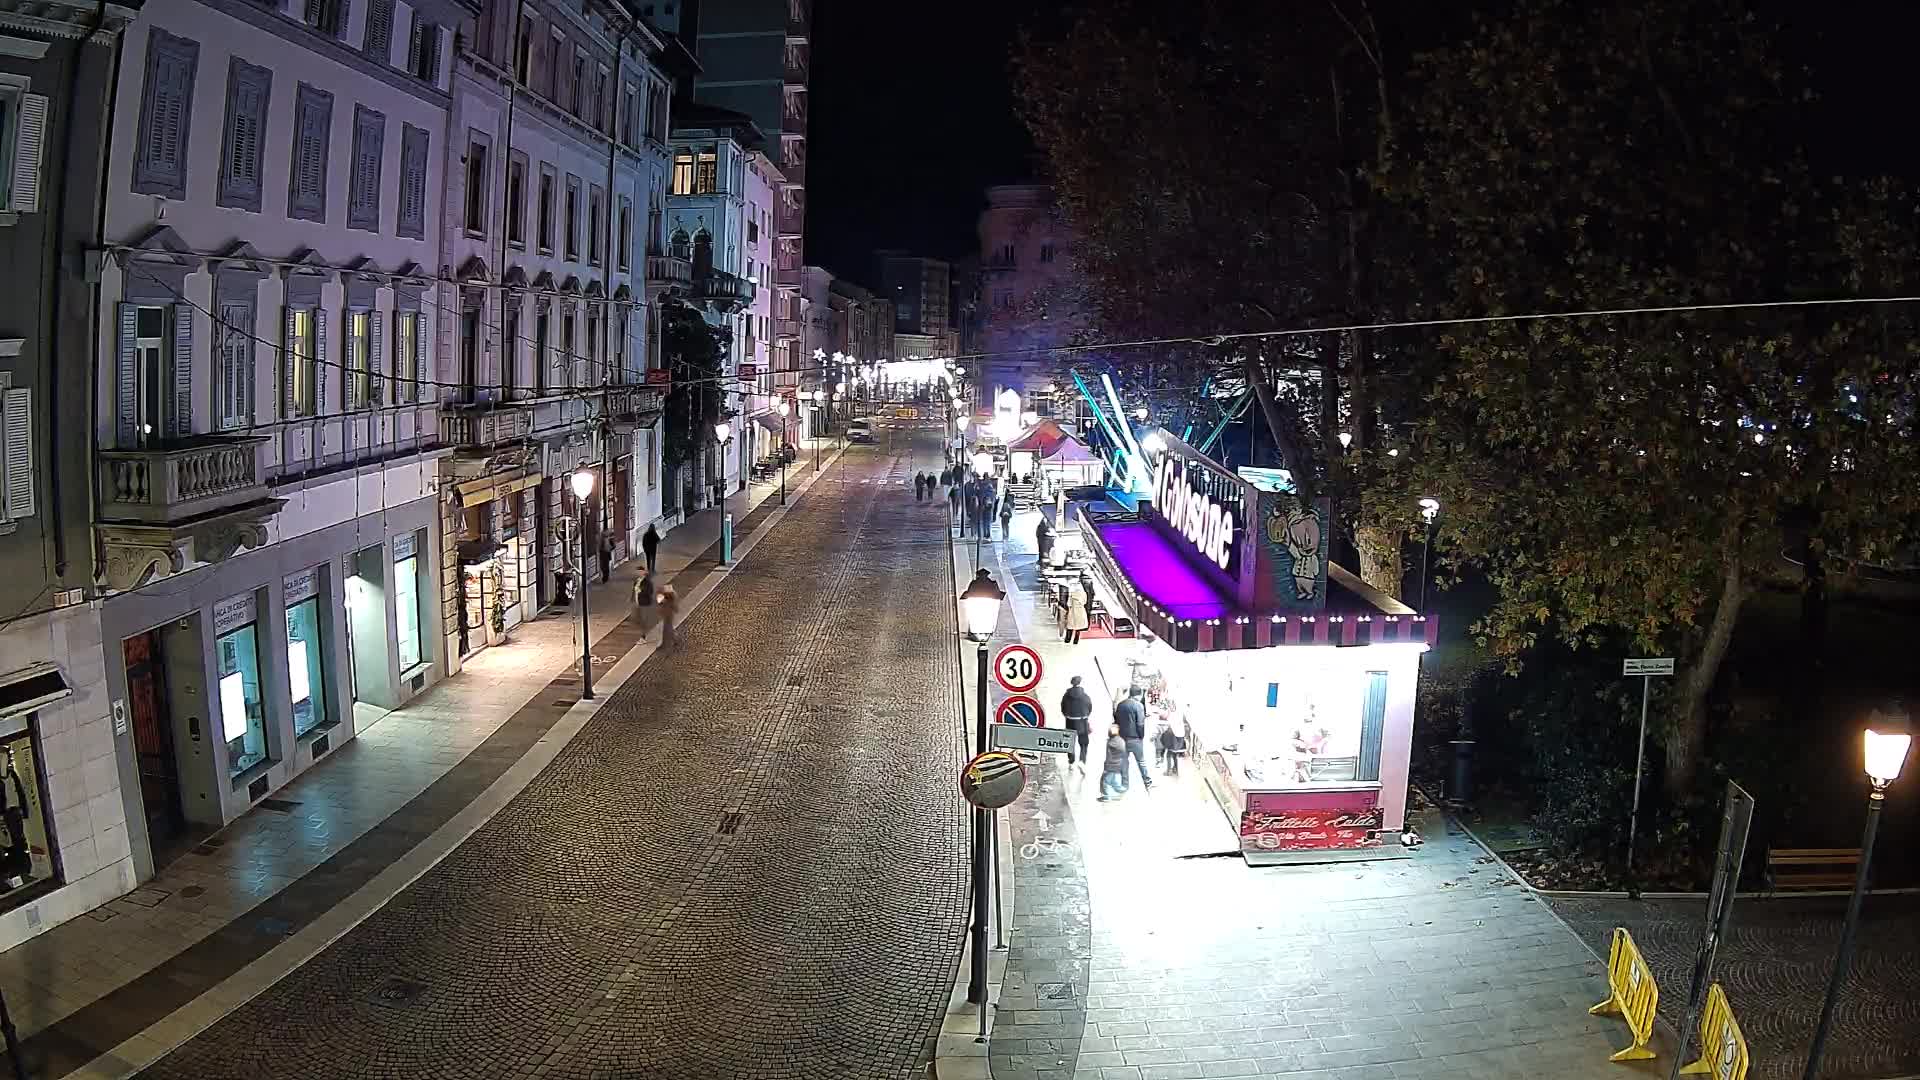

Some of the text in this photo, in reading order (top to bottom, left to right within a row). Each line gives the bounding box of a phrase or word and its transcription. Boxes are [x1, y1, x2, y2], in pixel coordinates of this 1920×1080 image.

[1162, 455, 1233, 570] Golosone
[1005, 657, 1033, 680] 30
[1038, 737, 1070, 750] Dante
